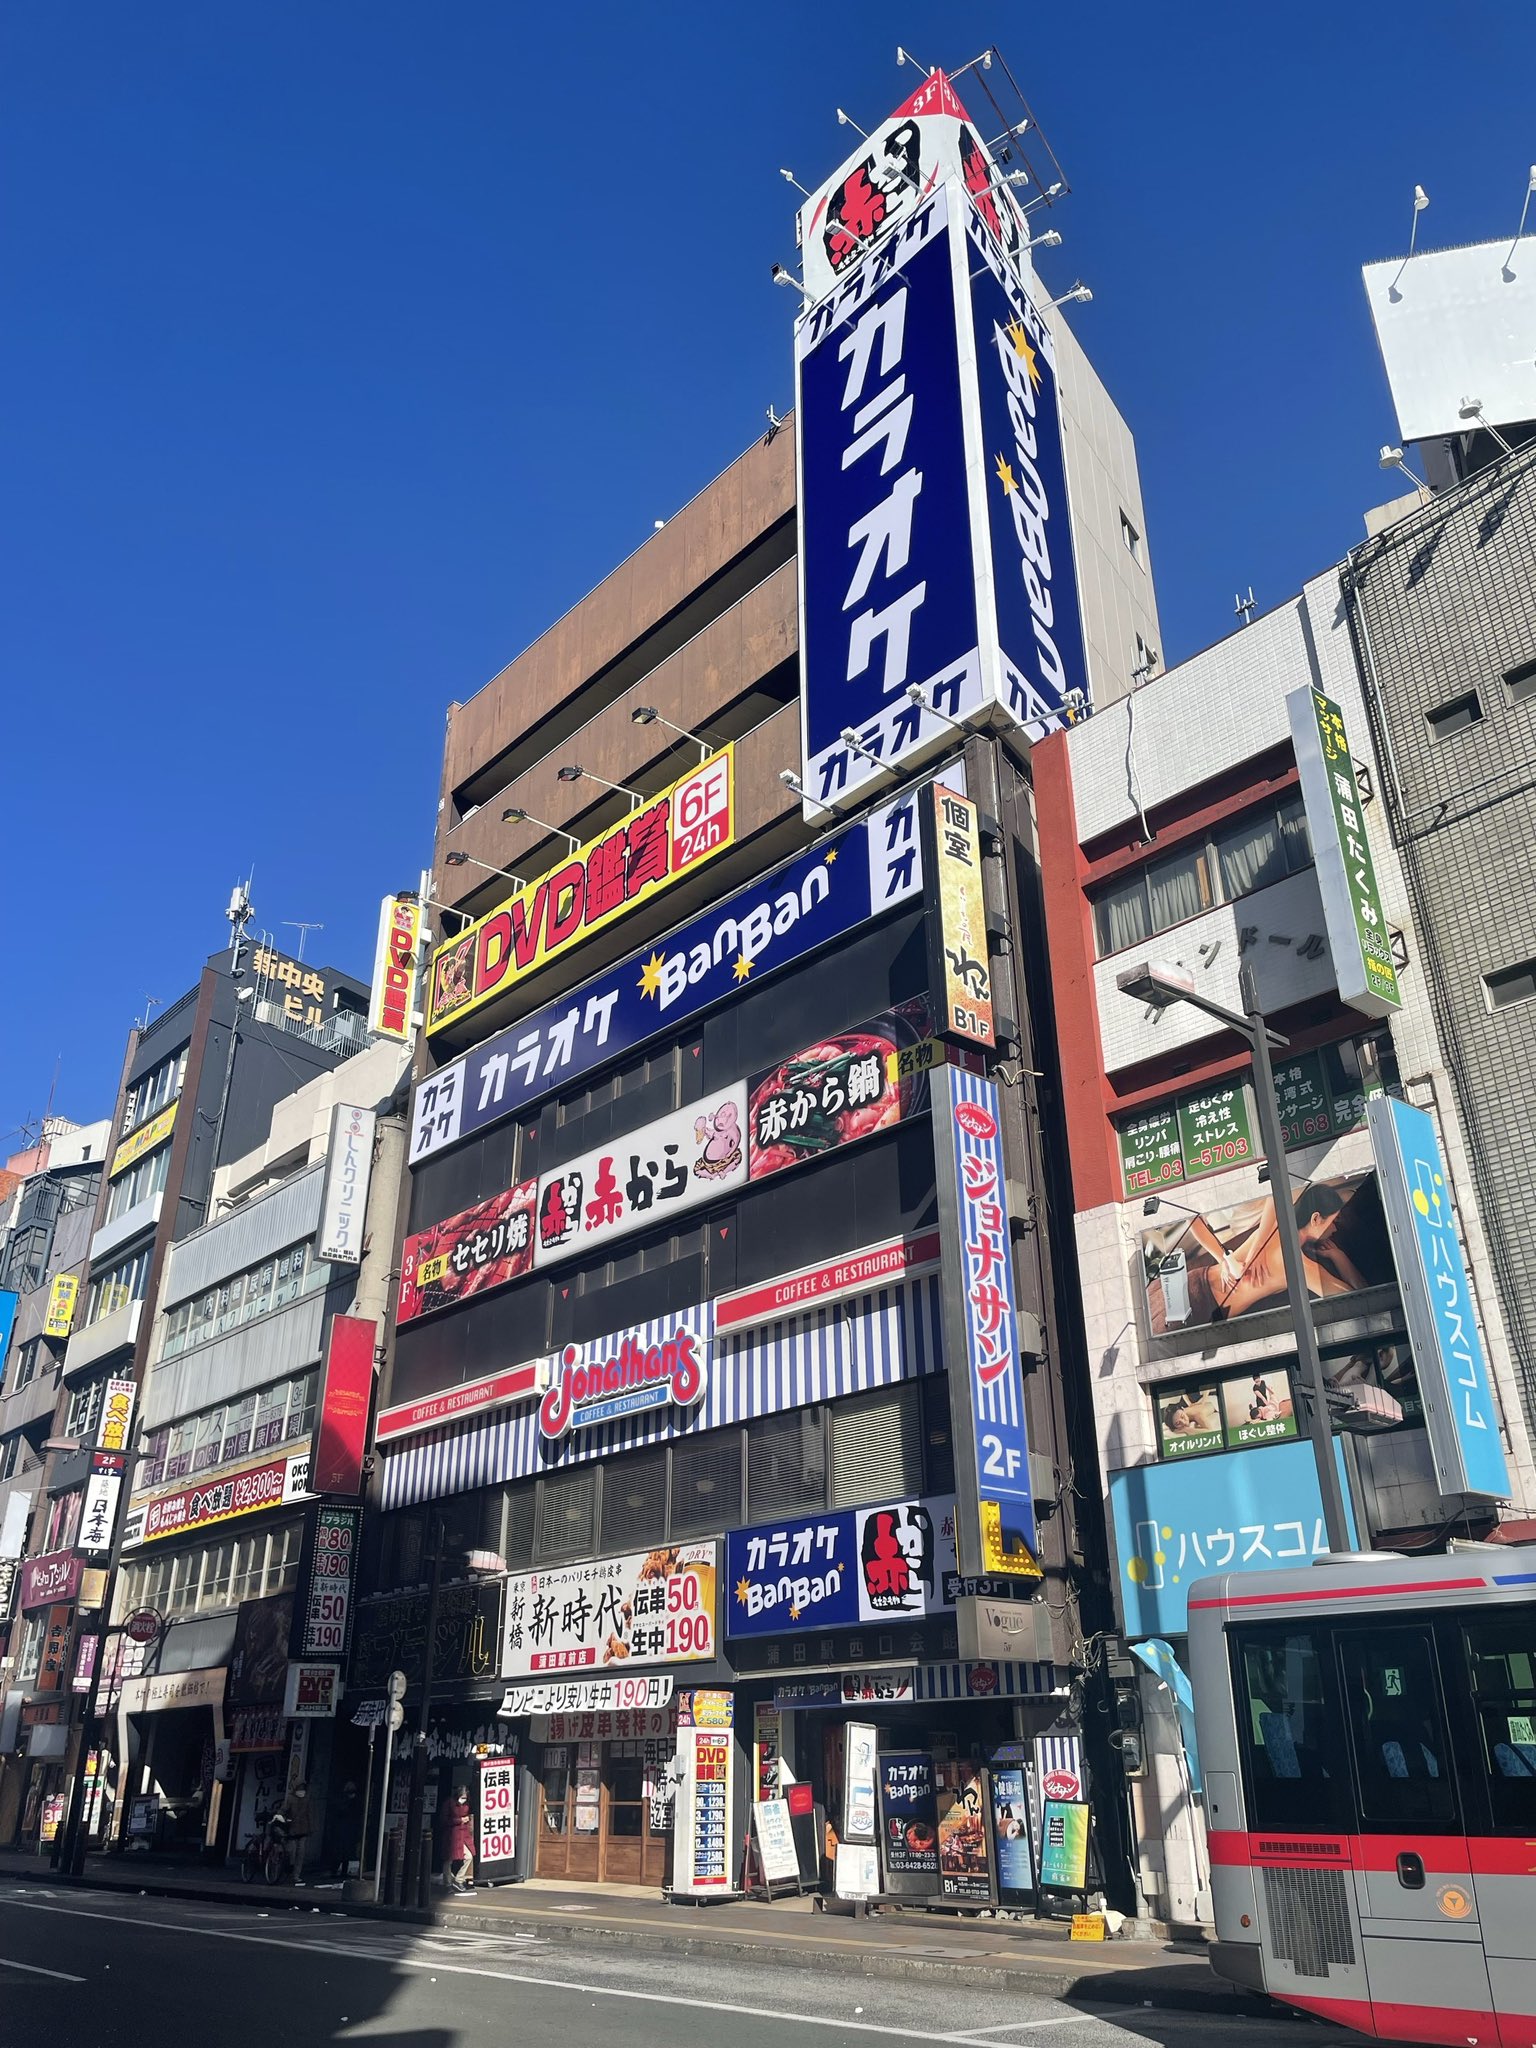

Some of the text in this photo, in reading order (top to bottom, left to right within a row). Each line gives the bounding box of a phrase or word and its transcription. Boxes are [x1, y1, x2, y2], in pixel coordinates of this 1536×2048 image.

[912, 80, 938, 114] 3F
[838, 286, 927, 694] カラオケ
[993, 318, 1066, 695] BanBan
[818, 668, 968, 801] カラオケ
[1314, 694, 1338, 761] マッサージ
[1330, 711, 1349, 755] 本格
[680, 773, 723, 829] 6F
[679, 822, 721, 865] 24h
[941, 797, 973, 867] 個室
[1333, 771, 1379, 927] 蒲田たくみ
[475, 797, 672, 997] DVD鑑賞
[658, 863, 831, 1013] BanBan
[1361, 939, 1392, 965] リラックス
[1364, 928, 1384, 948] 全身
[252, 949, 326, 1002] 新中央
[1366, 956, 1394, 982] 指の匠
[284, 994, 324, 1030] ビル
[954, 1006, 989, 1038] B1F
[477, 988, 620, 1112] カラオケ
[897, 1042, 934, 1074] 名物
[422, 1070, 457, 1117] カラ
[759, 1053, 881, 1145] 赤から鍋
[1188, 1090, 1234, 1115] 足むくみ
[416, 1107, 456, 1154] オケ
[1192, 1123, 1239, 1147] ストレス
[1194, 1111, 1232, 1128] 冷え性
[1134, 1130, 1168, 1150] リンパ
[584, 1143, 689, 1232] 赤から
[1127, 1159, 1183, 1190] TEL.03
[452, 1211, 528, 1273] セセリ焼
[400, 1254, 414, 1305] 3F
[422, 1258, 443, 1279] 名物
[775, 1246, 915, 1304] COFFEE & RESTAURANT
[962, 1154, 1012, 1385] ジョナサン
[1432, 1233, 1488, 1431] ハウスコム
[541, 1326, 702, 1437] jonathan's
[412, 1384, 494, 1421] COFFEE & RESTAURANT
[580, 1391, 659, 1422] COFFEE & RESTAURANT
[102, 1391, 131, 1450] 食べ放題
[1238, 1422, 1286, 1441] ほぐし整体
[101, 1455, 116, 1465] 2F
[982, 1433, 1022, 1479] 2F
[1169, 1434, 1222, 1453] オイルリンパ
[188, 1481, 234, 1520] 食べ放題
[84, 1499, 109, 1544] 日本海
[326, 1516, 354, 1526] ブラジル
[328, 1528, 352, 1551] 80
[747, 1525, 839, 1571] カラオケ
[325, 1554, 348, 1575] 190
[319, 1582, 347, 1594] 新時代
[513, 1580, 526, 1594] 東京
[632, 1585, 666, 1617] 伝串
[667, 1575, 698, 1613] 50
[745, 1568, 841, 1617] BanBan
[321, 1595, 345, 1621] 50
[508, 1596, 526, 1651] 新橋
[528, 1584, 624, 1647] 新時代
[985, 1608, 1024, 1632] Vogue
[315, 1626, 341, 1648] 190
[631, 1626, 665, 1657] 生中
[666, 1614, 709, 1654] 190
[299, 1677, 333, 1691] DVD
[501, 1678, 670, 1714] コンビニより安い生中190円!
[778, 1684, 805, 1698] カラオケ
[809, 1681, 838, 1697] BanBan
[678, 1714, 692, 1726] 24h
[696, 1747, 727, 1764] DVD
[483, 1769, 511, 1788] 伝串
[888, 1765, 929, 1782] カラオケ
[484, 1787, 510, 1811] 50
[890, 1783, 931, 1800] BanBan
[483, 1815, 511, 1835] 生中
[481, 1833, 512, 1859] 190
[944, 1879, 958, 1894] B1F
